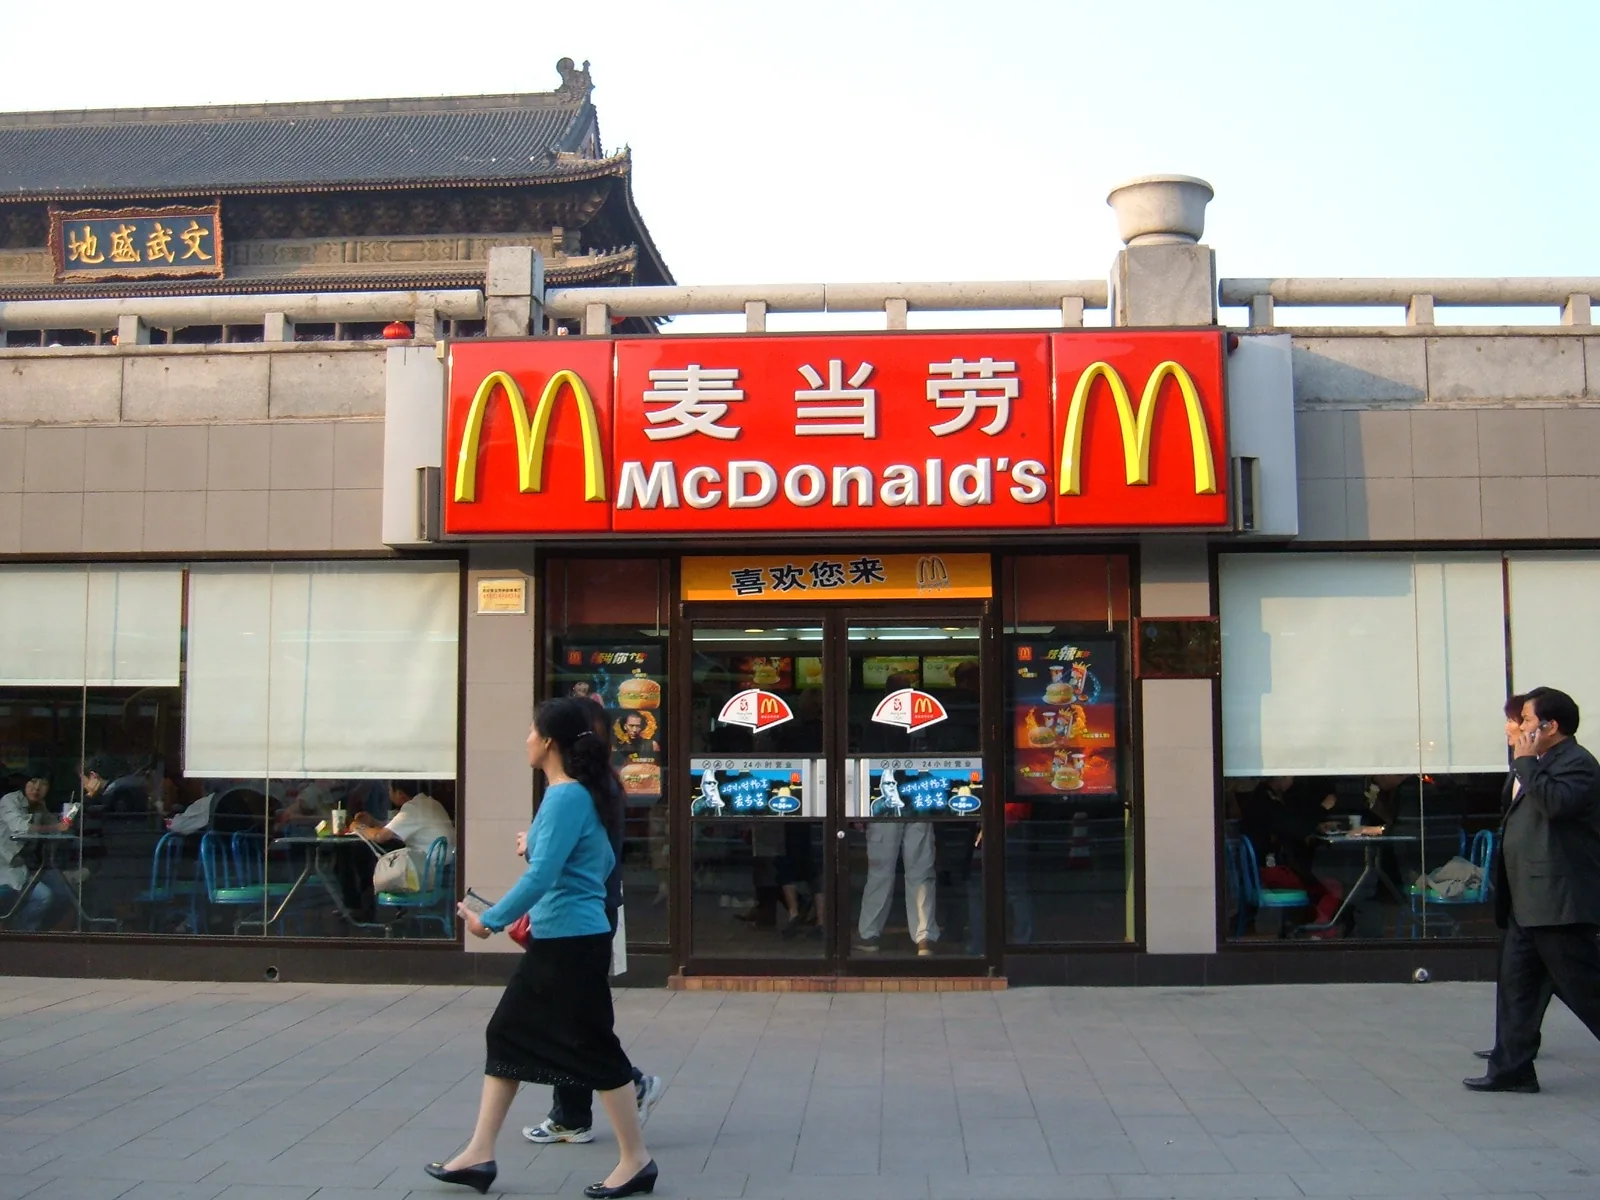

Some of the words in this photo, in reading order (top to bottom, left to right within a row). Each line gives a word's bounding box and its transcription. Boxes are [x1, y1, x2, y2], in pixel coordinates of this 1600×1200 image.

[642, 358, 1020, 440] 麦当劳
[616, 456, 1048, 510] McDonald's
[731, 557, 888, 597] 喜欢您来
[743, 761, 793, 769] 24小时营业
[922, 760, 972, 768] 24小时营业
